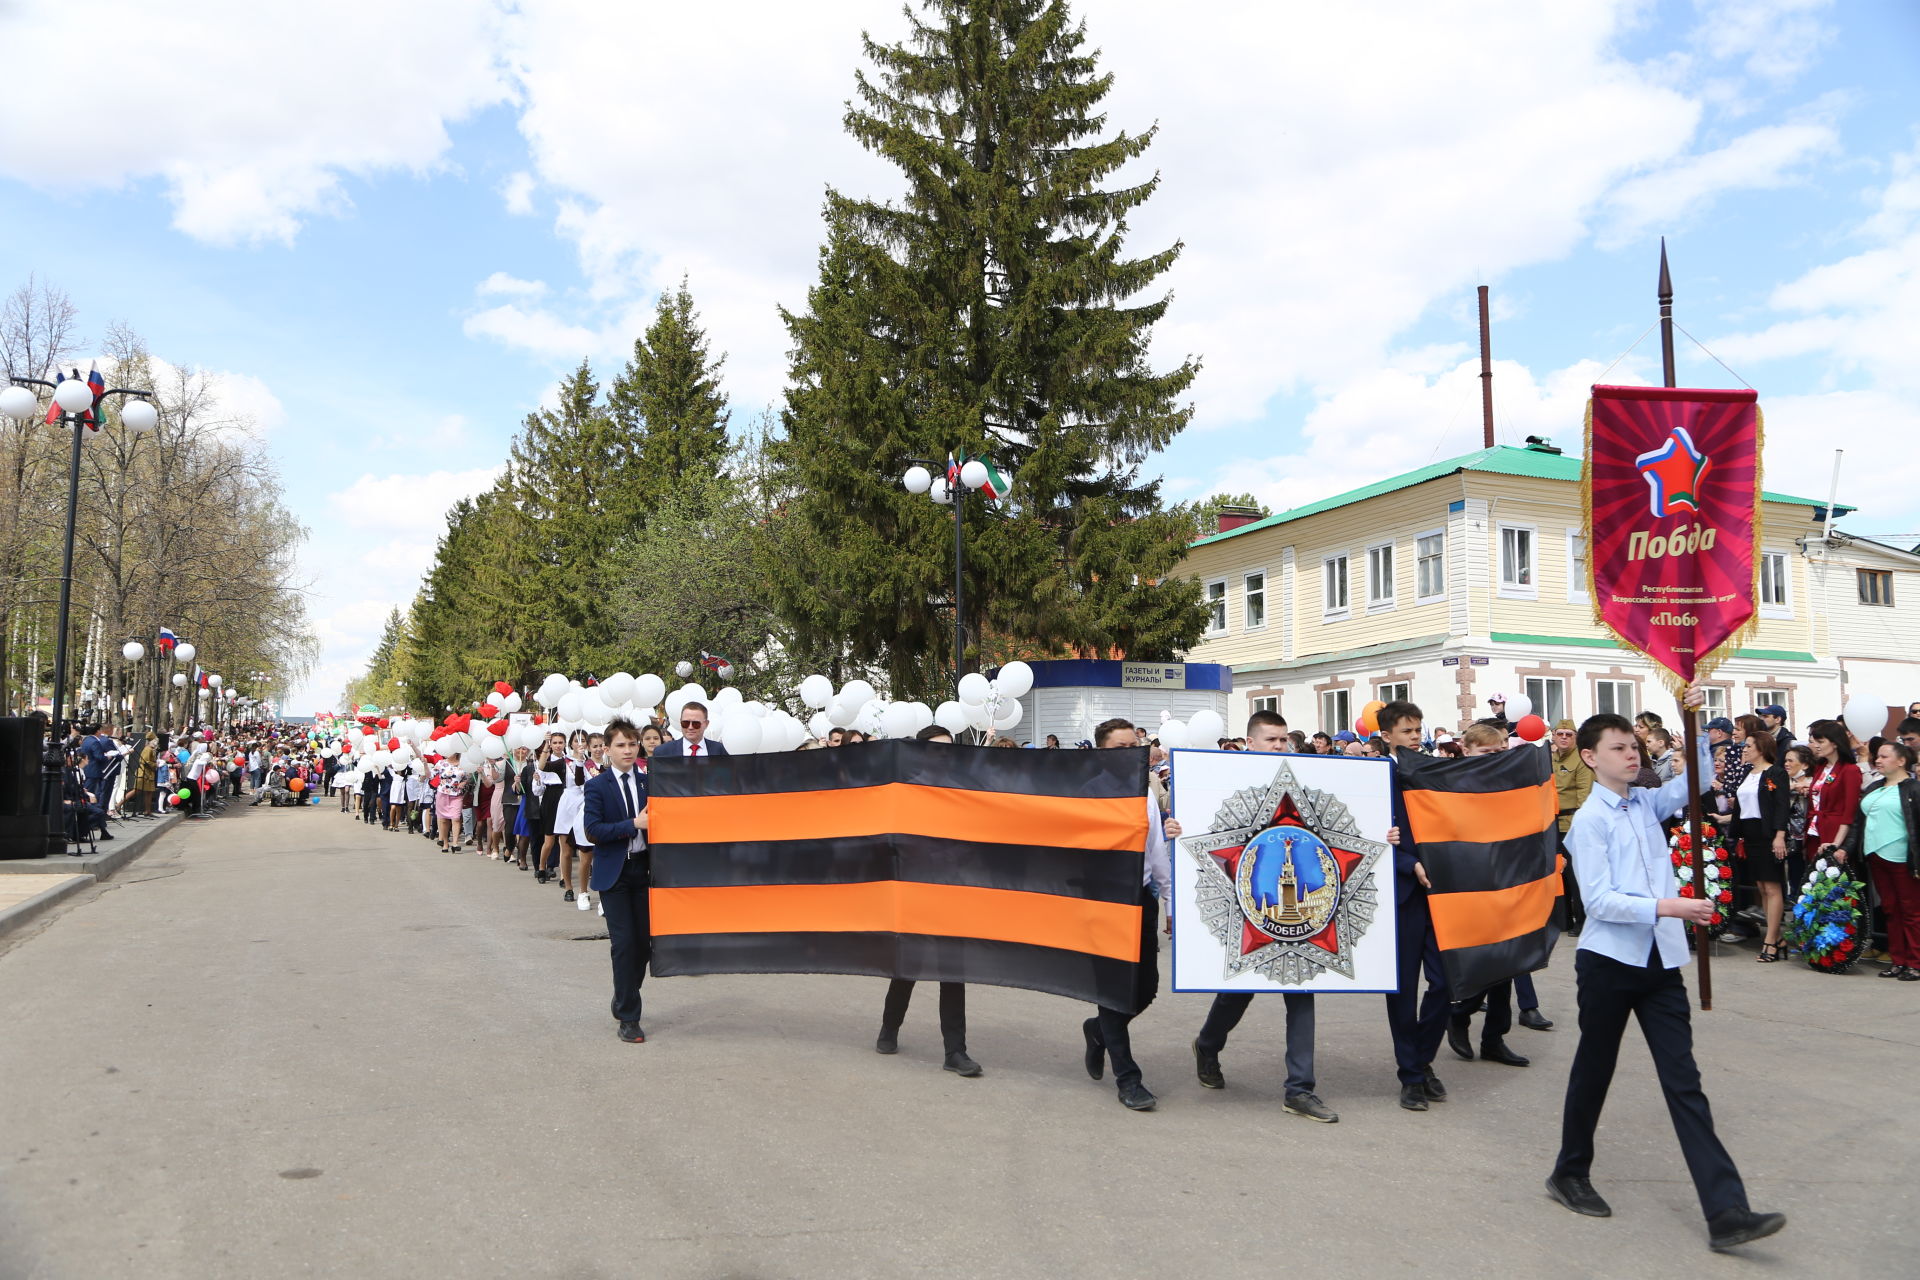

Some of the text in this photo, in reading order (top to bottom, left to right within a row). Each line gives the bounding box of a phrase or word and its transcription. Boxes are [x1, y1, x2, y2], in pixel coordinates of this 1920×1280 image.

[1125, 667, 1153, 675] ГАЗЕТЫ
[1125, 675, 1162, 684] ЖУРНАЛЫ
[1267, 831, 1310, 844] СССР
[1266, 921, 1312, 936] ПОБЕДА
